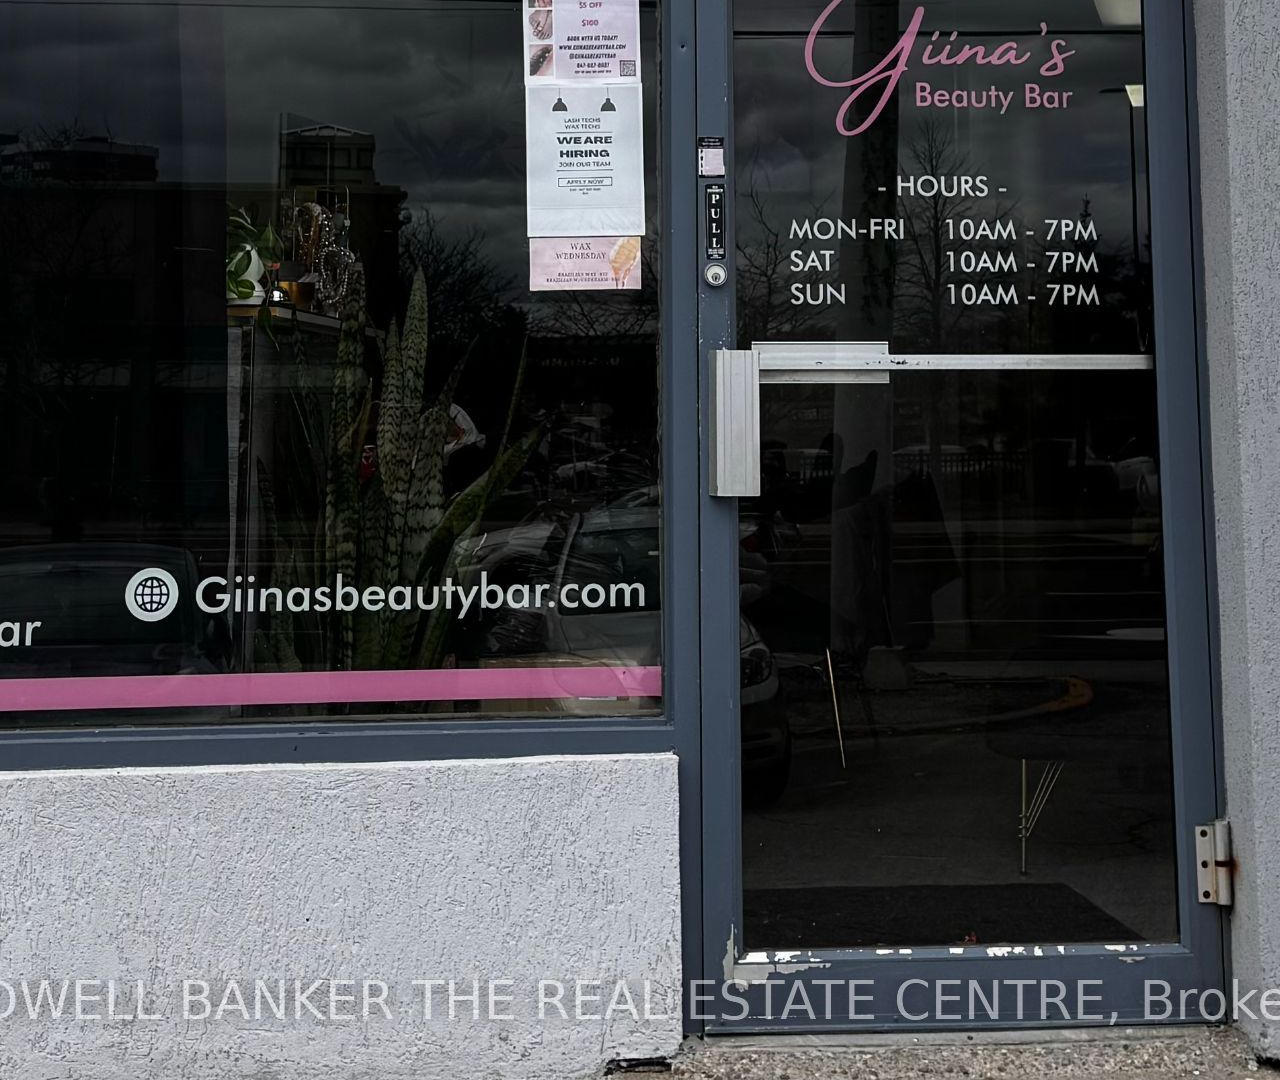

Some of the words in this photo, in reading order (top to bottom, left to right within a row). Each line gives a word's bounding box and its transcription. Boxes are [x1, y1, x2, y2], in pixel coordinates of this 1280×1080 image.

[915, 82, 1014, 115] Beauty
[1024, 83, 1073, 109] Bar
[556, 136, 582, 145] WE
[583, 135, 613, 145] ARE
[559, 149, 610, 158] HIRING
[896, 175, 989, 197] HOURS
[710, 193, 721, 248] PULL
[789, 218, 905, 240] MON-FRI
[945, 218, 1017, 241] 10AM
[1044, 219, 1098, 242] 7PM
[555, 252, 607, 260] WEDNESDAY
[570, 242, 592, 251] WAX
[789, 250, 835, 272] SAT
[946, 250, 1018, 273] 10AM
[1045, 251, 1099, 274] 7PM
[790, 283, 846, 305] SUN
[947, 283, 1019, 305] 10AM
[1046, 284, 1100, 306] 7PM
[195, 571, 646, 620] Giinasbeautybar.com
